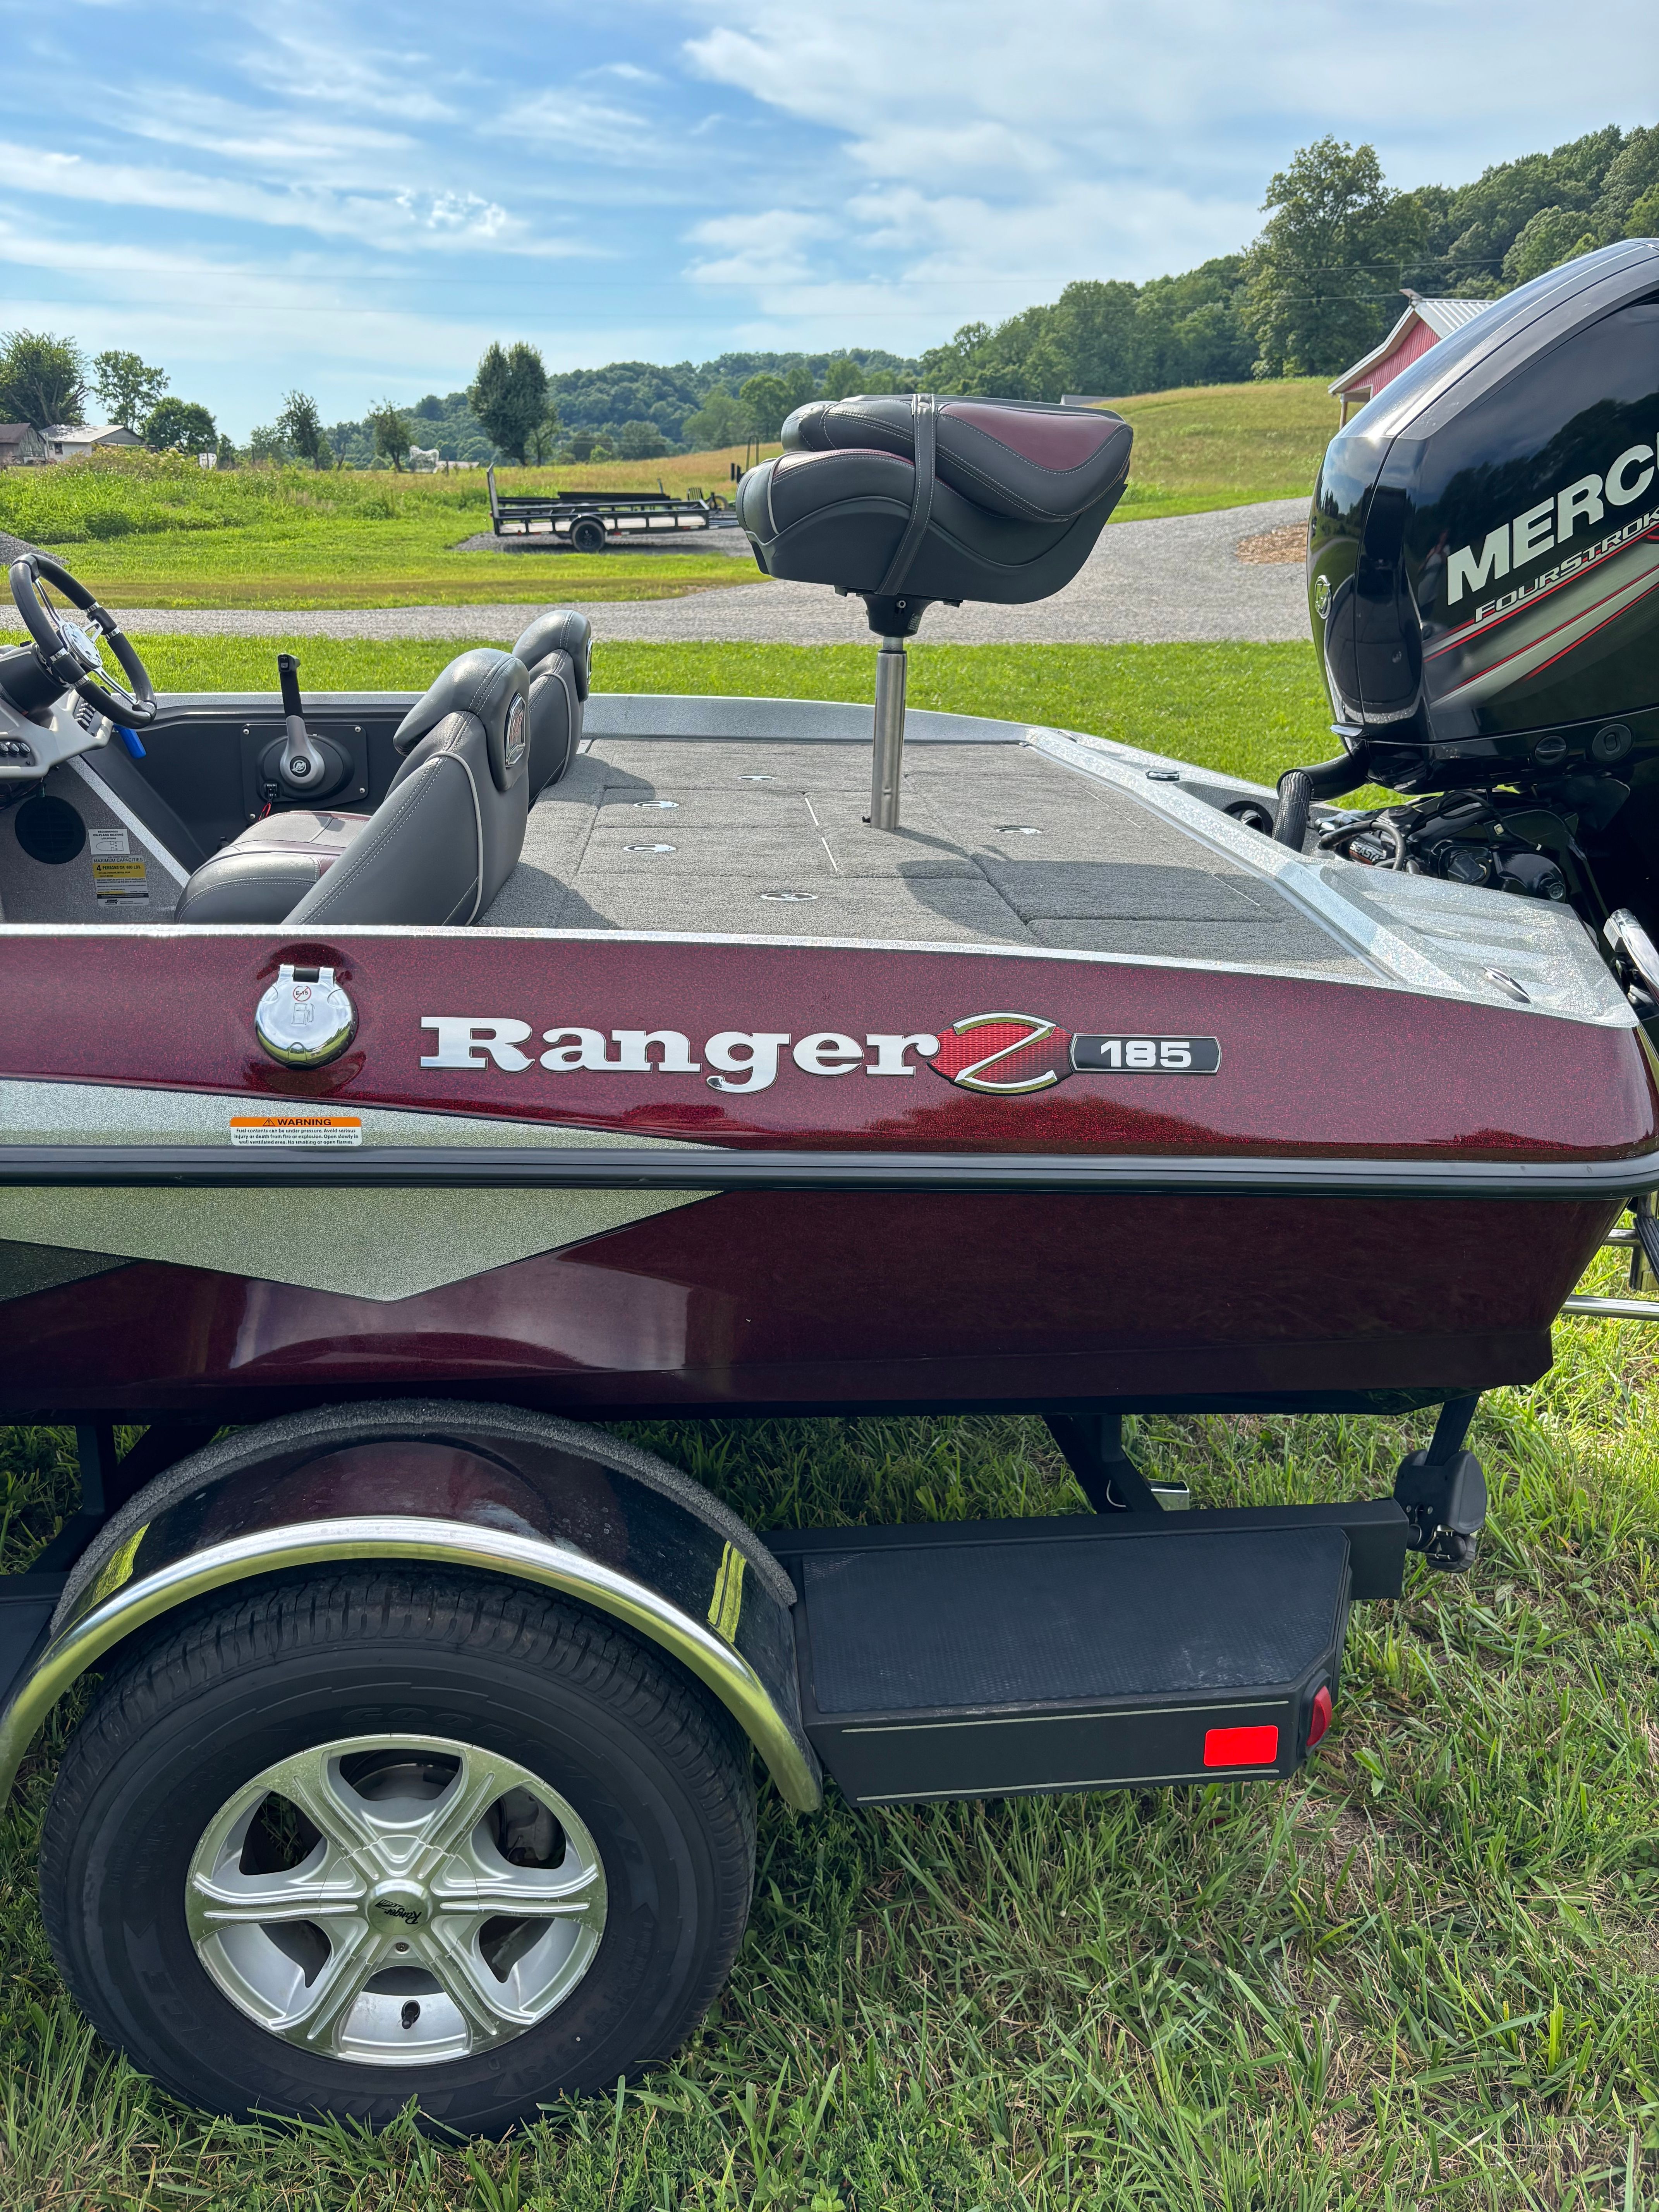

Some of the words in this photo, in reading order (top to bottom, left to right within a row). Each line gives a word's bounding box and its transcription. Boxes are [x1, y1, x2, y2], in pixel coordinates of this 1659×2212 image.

[1448, 432, 1659, 605] MERC
[419, 1016, 940, 1095] Ranger
[1101, 1041, 1191, 1068] 185
